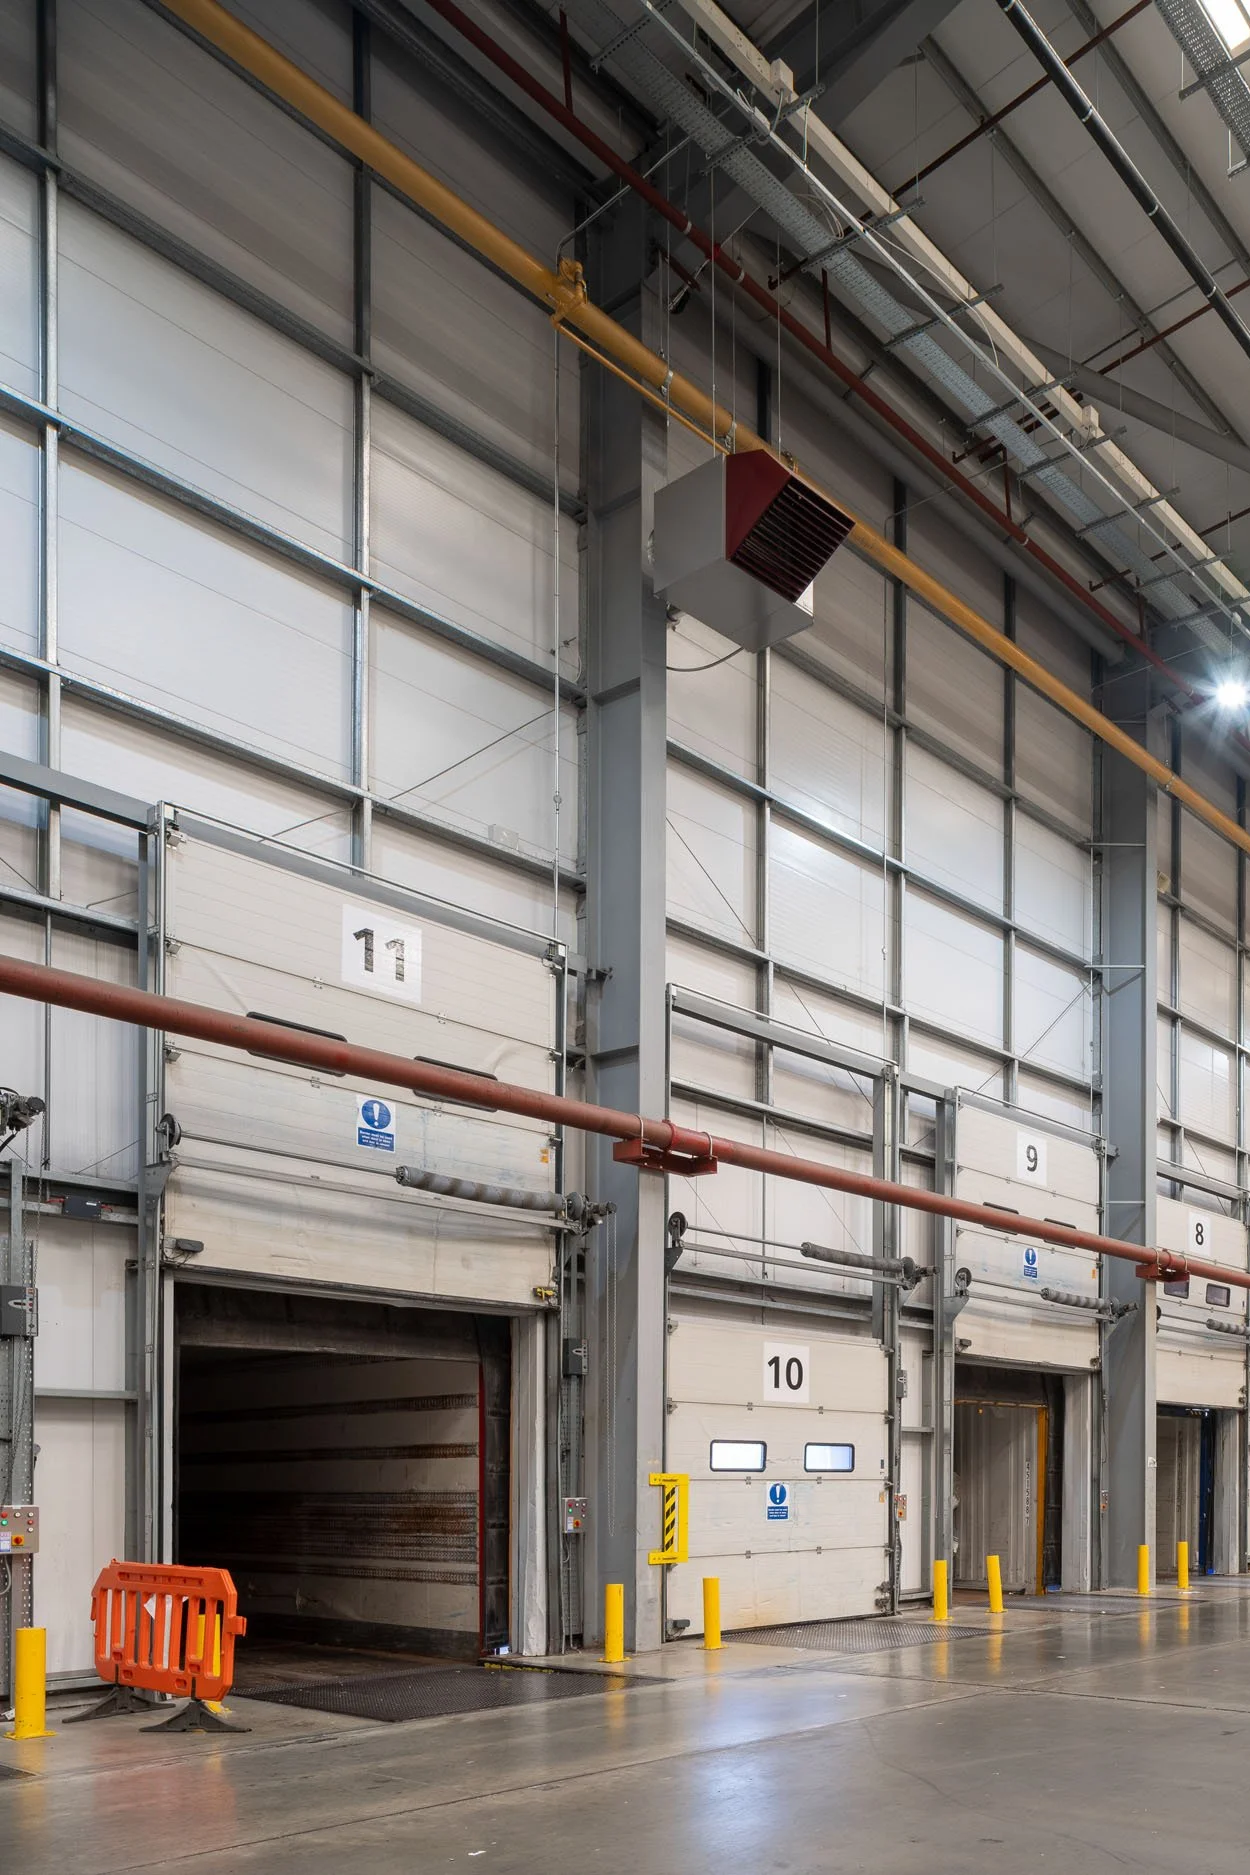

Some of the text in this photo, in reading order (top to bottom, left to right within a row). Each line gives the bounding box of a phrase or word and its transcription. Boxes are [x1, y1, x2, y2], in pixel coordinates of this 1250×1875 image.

[352, 928, 404, 982] 11
[1026, 1144, 1038, 1172] 9
[1195, 1222, 1204, 1246] 8
[767, 1355, 804, 1390] 10
